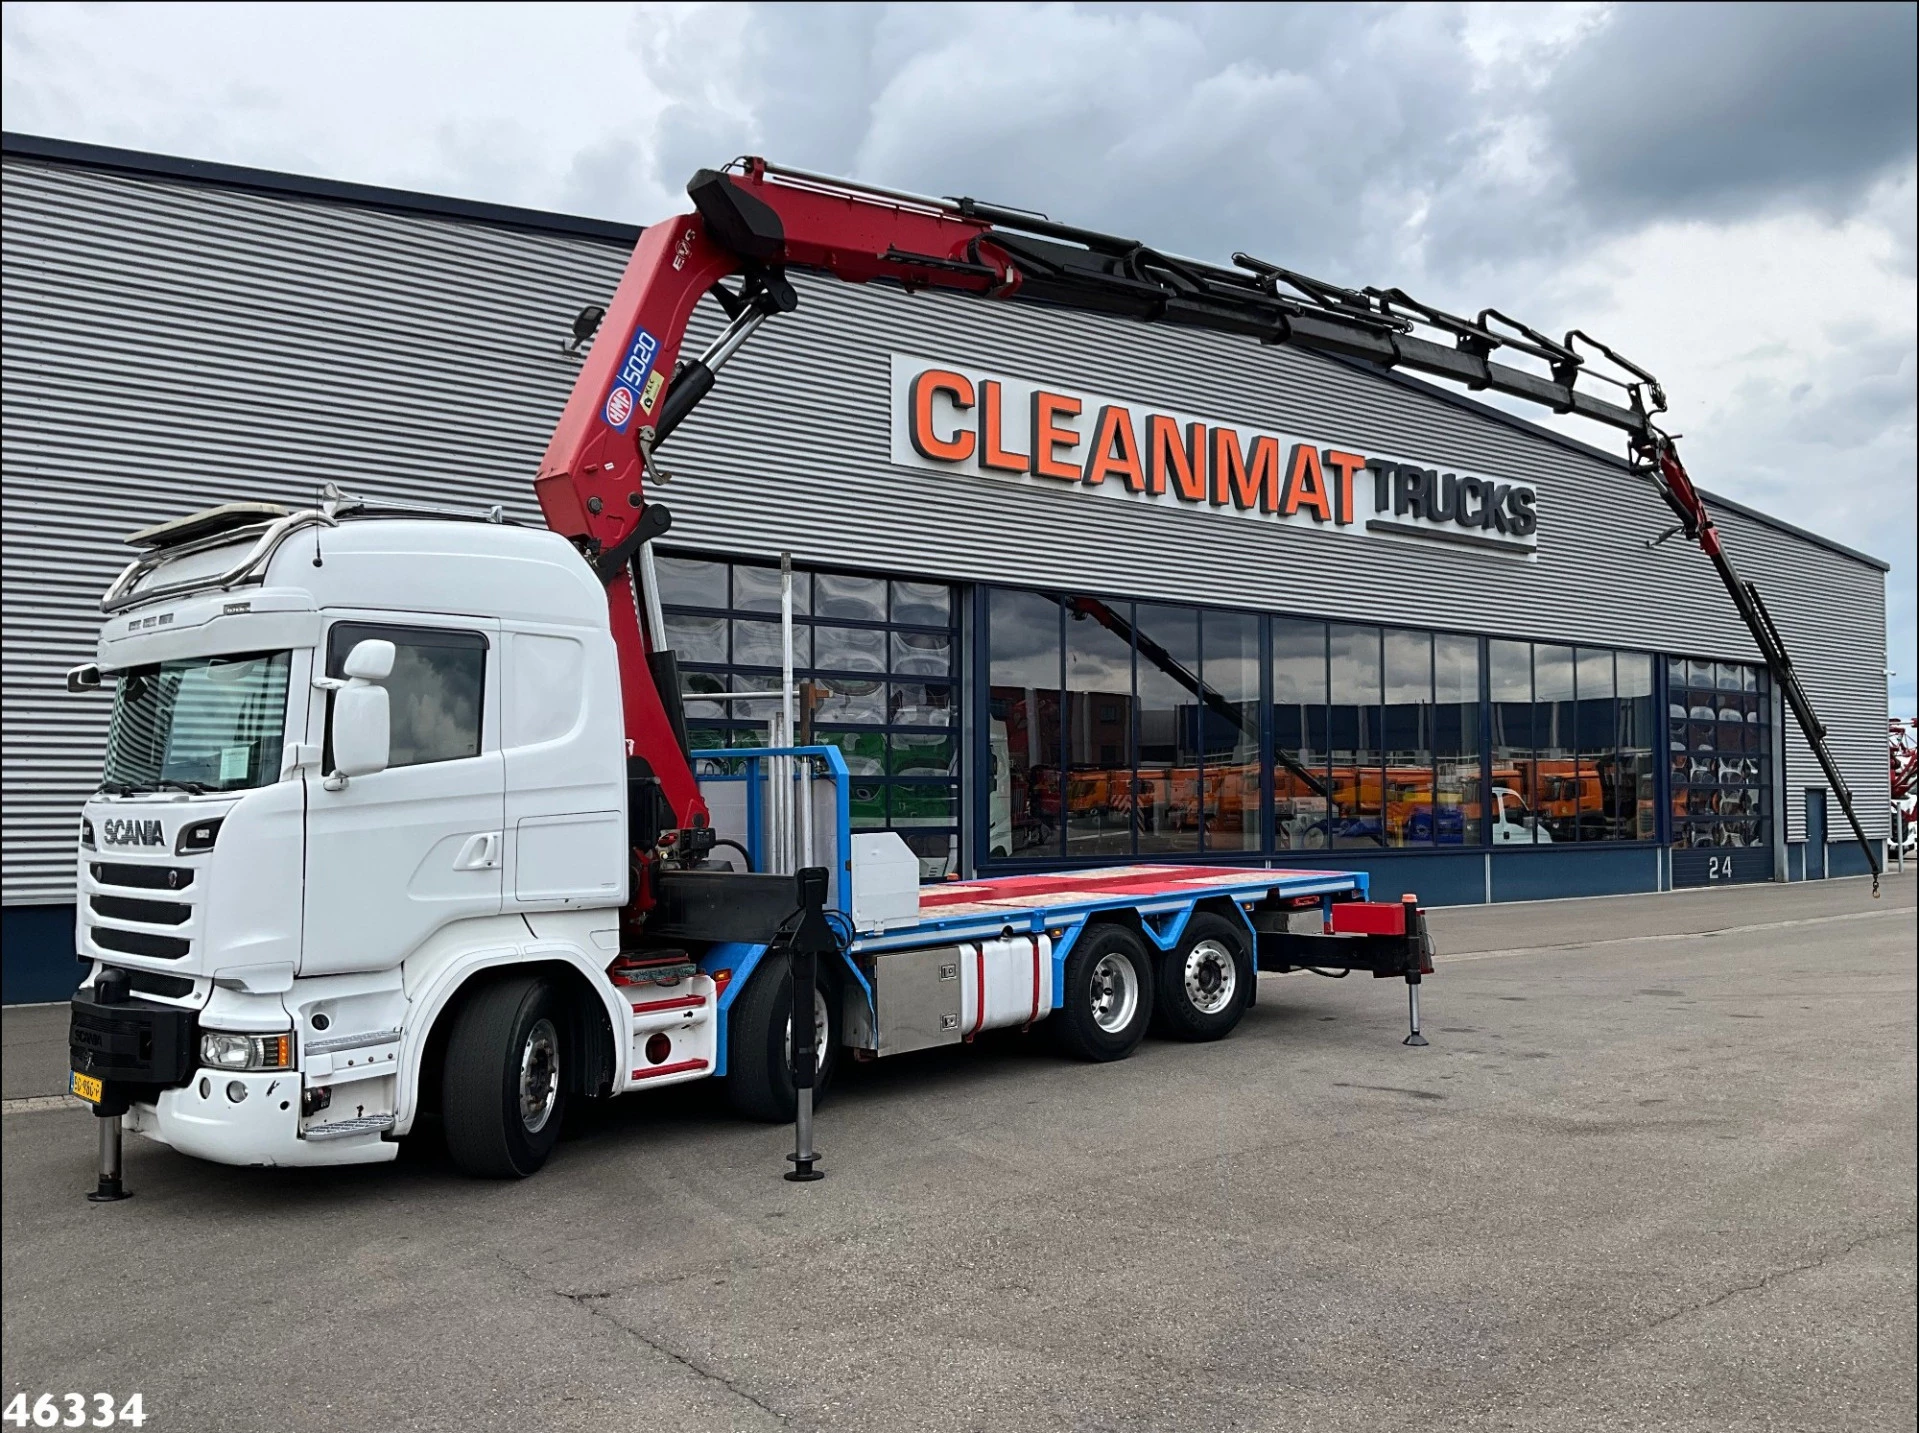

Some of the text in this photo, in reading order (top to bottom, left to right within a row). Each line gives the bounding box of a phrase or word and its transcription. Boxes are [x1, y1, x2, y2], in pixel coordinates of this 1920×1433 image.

[610, 331, 656, 421] HMF 5020
[909, 369, 1536, 536] CLEANMAT TRUCKS
[104, 818, 166, 847] SCANIA
[1709, 855, 1732, 878] 24
